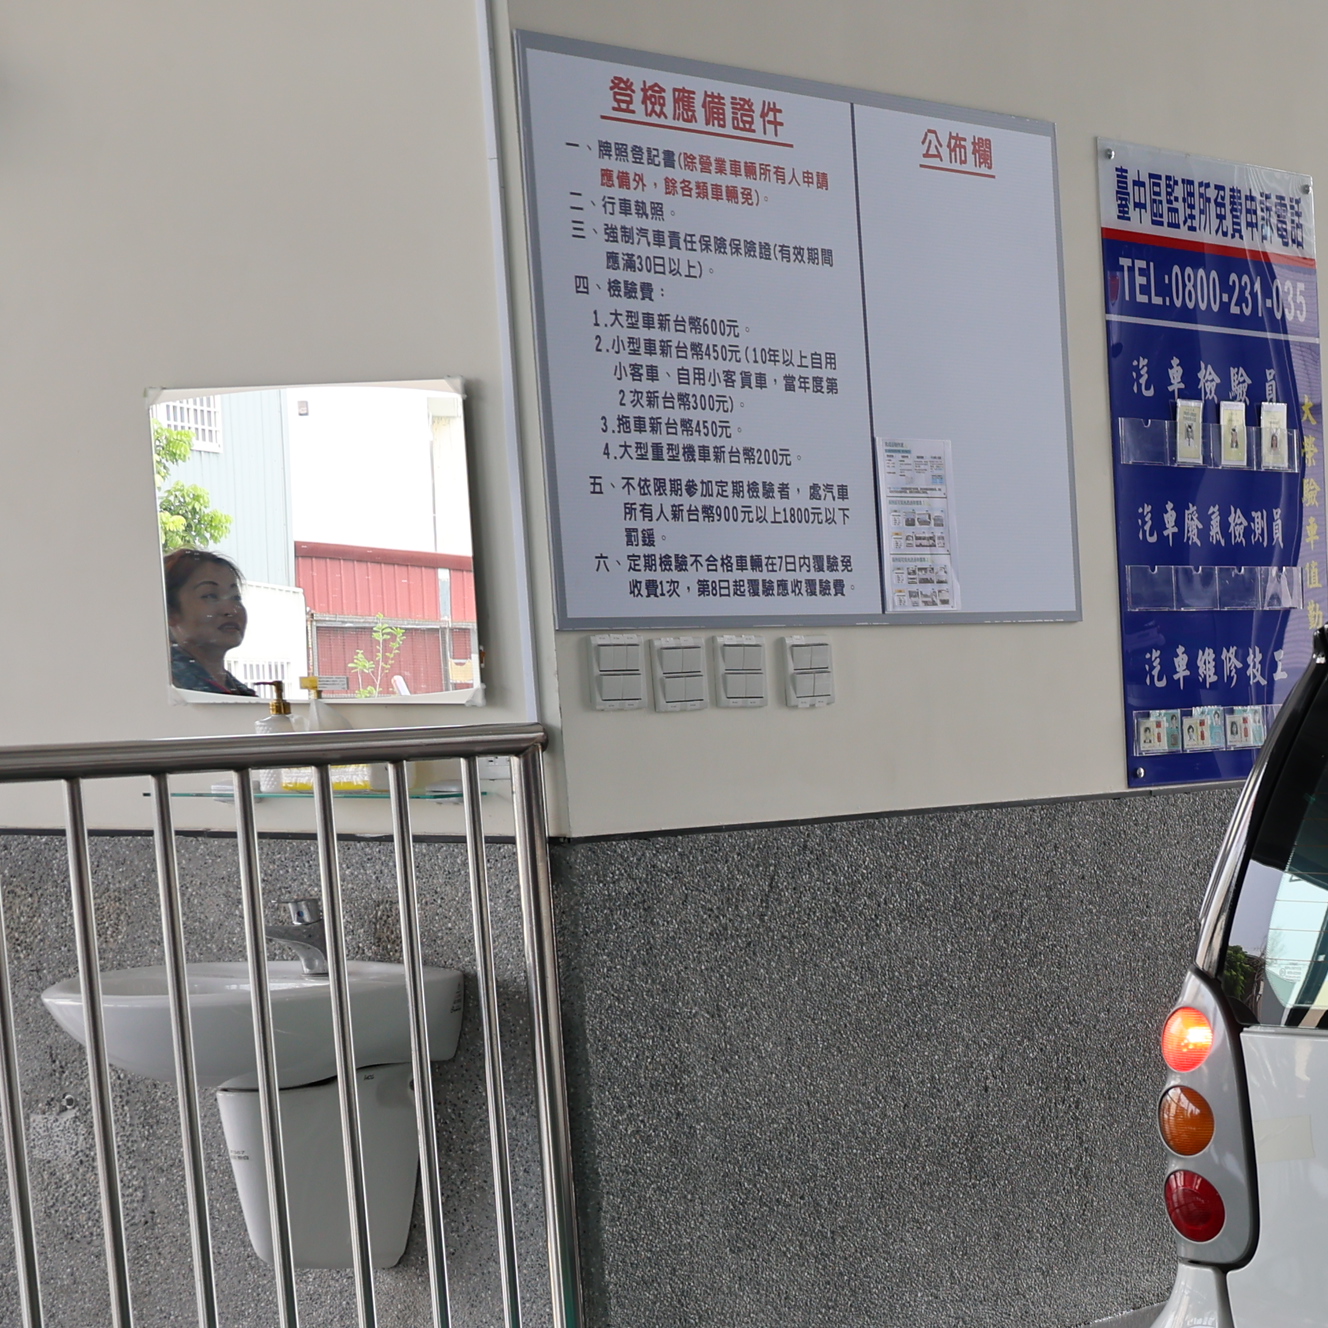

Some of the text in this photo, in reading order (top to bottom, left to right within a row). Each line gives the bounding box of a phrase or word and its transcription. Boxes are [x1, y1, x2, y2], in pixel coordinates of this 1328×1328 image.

[609, 75, 785, 138] 登檢應備證件
[920, 128, 994, 171] 公佈欄
[1115, 165, 1306, 250] 臺中區監理所免費申訴電話
[1119, 256, 1307, 323] TEL:0800-231-035
[1131, 355, 1279, 406] 汽車檢驗員
[1138, 500, 1285, 550] 汽車廢氣檢測員
[1145, 644, 1288, 691] 汽車維修技工
